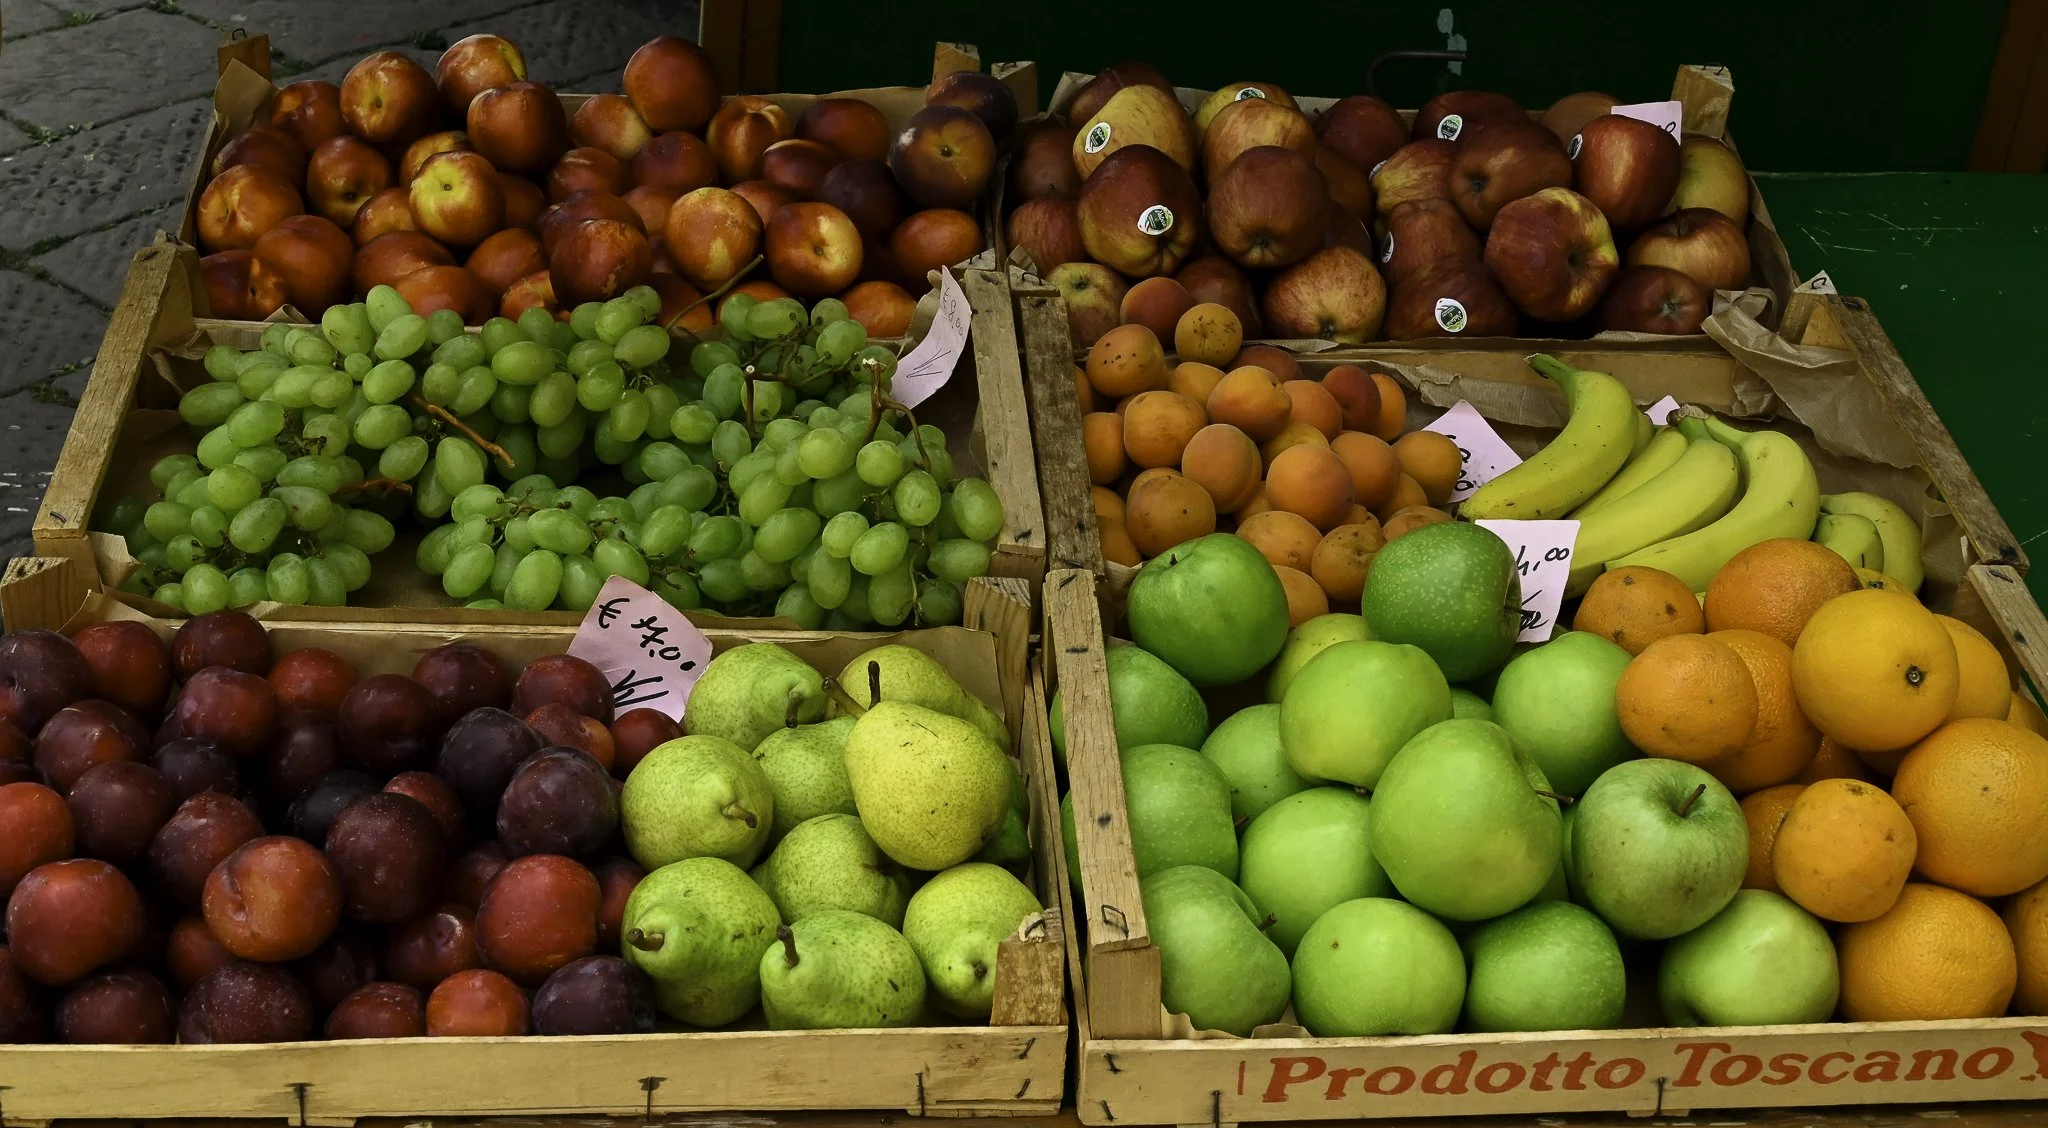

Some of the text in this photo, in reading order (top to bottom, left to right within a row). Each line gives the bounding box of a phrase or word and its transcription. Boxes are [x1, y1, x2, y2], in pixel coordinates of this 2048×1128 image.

[598, 597, 631, 629] €
[1262, 1041, 2014, 1103] Prodotto Toscano
